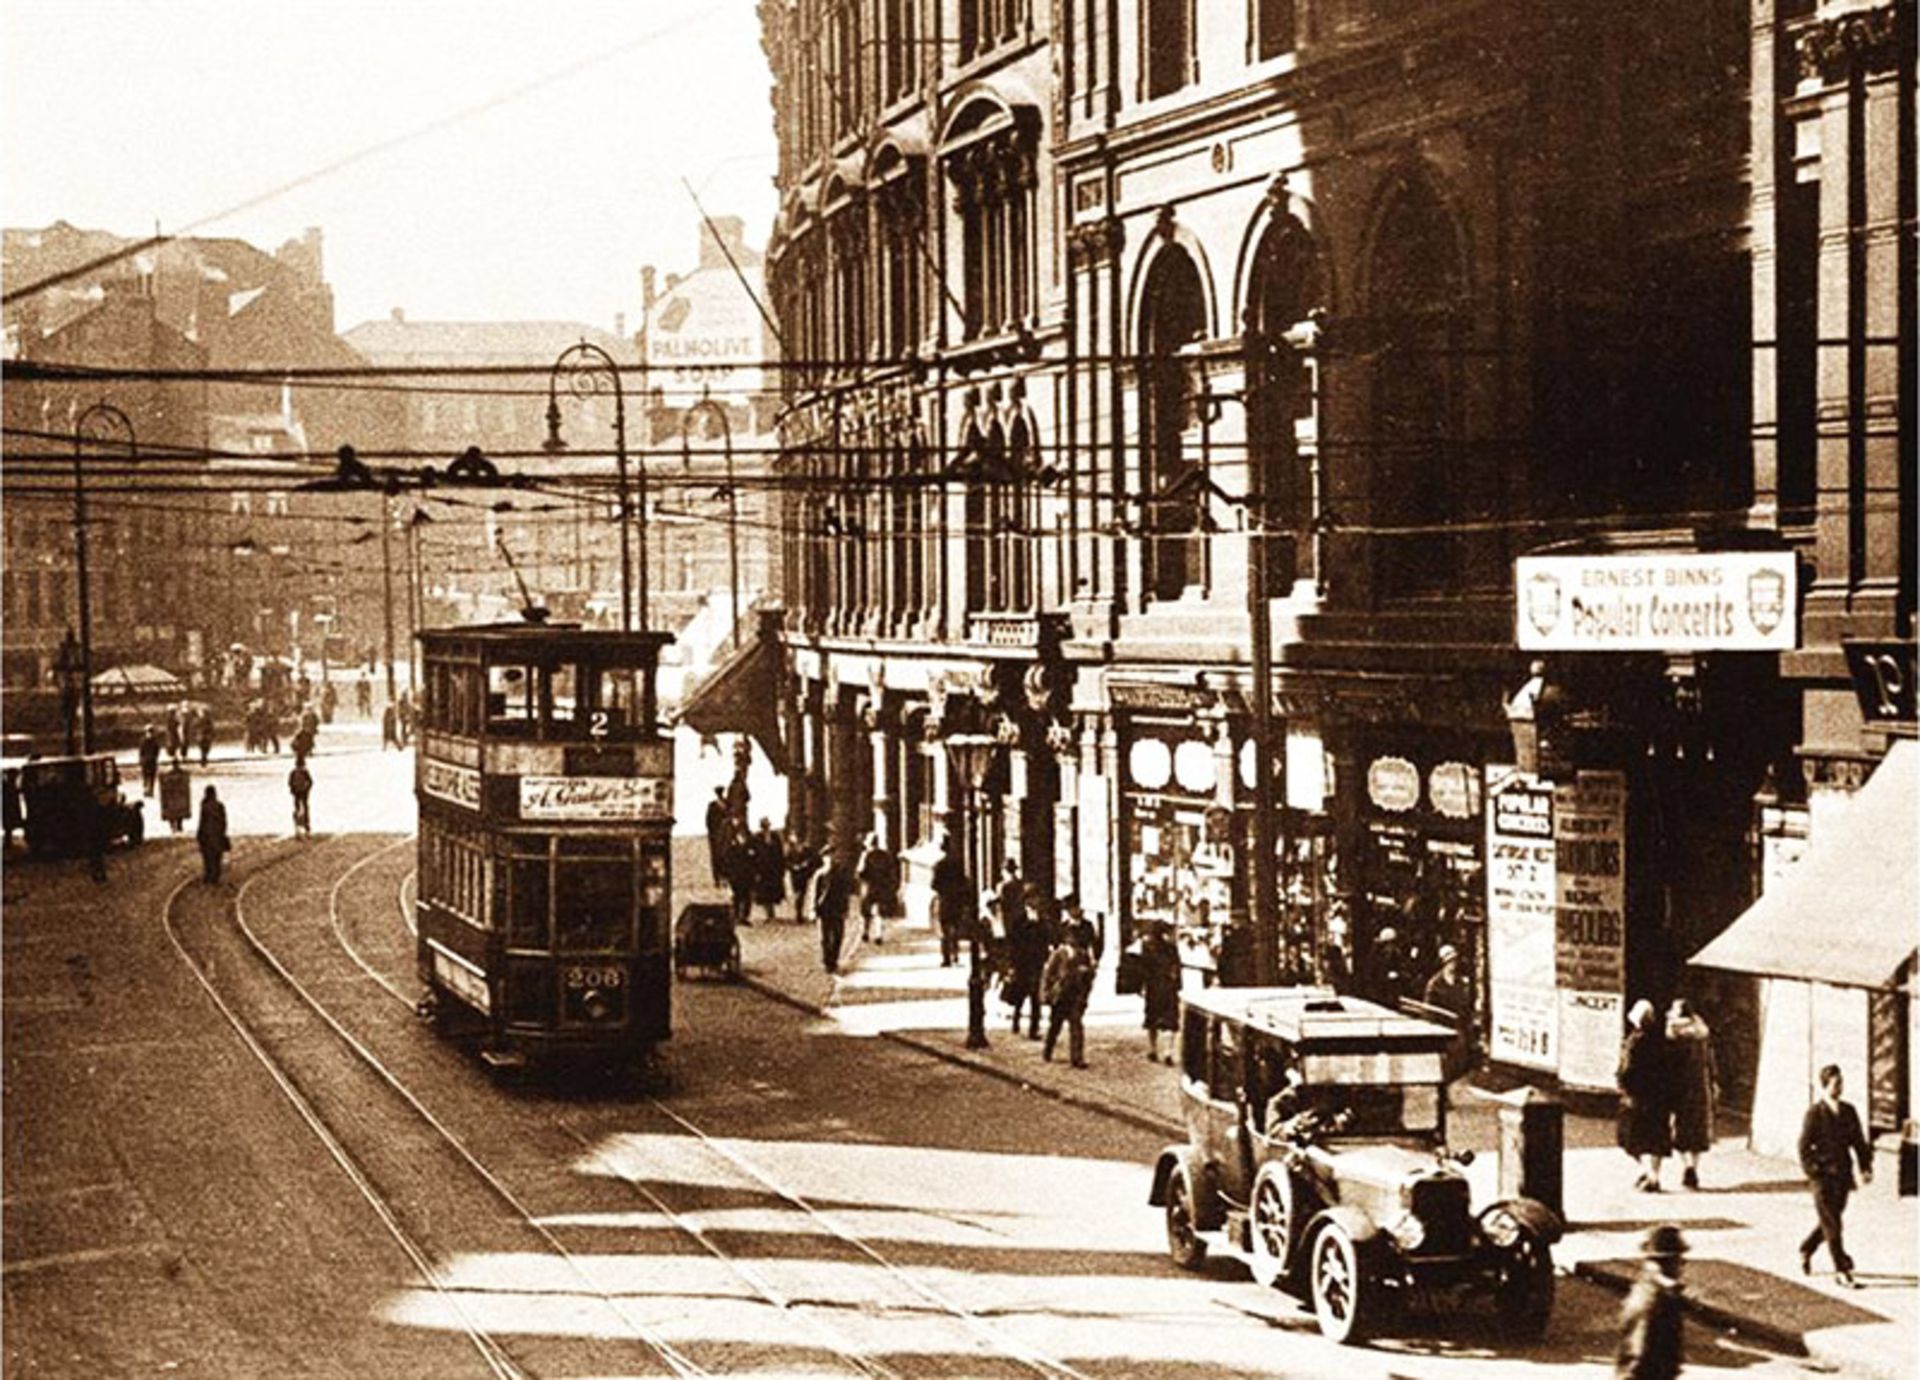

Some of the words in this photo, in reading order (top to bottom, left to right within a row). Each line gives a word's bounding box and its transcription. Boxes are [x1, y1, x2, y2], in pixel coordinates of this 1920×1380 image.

[653, 338, 752, 359] PALMOLIVE
[675, 364, 733, 383] SOAP
[1582, 568, 1655, 587] ERNEST
[1665, 566, 1725, 587] BINNS
[1572, 593, 1642, 641] Popular
[1650, 592, 1734, 637] Concerts
[590, 713, 609, 736] 2
